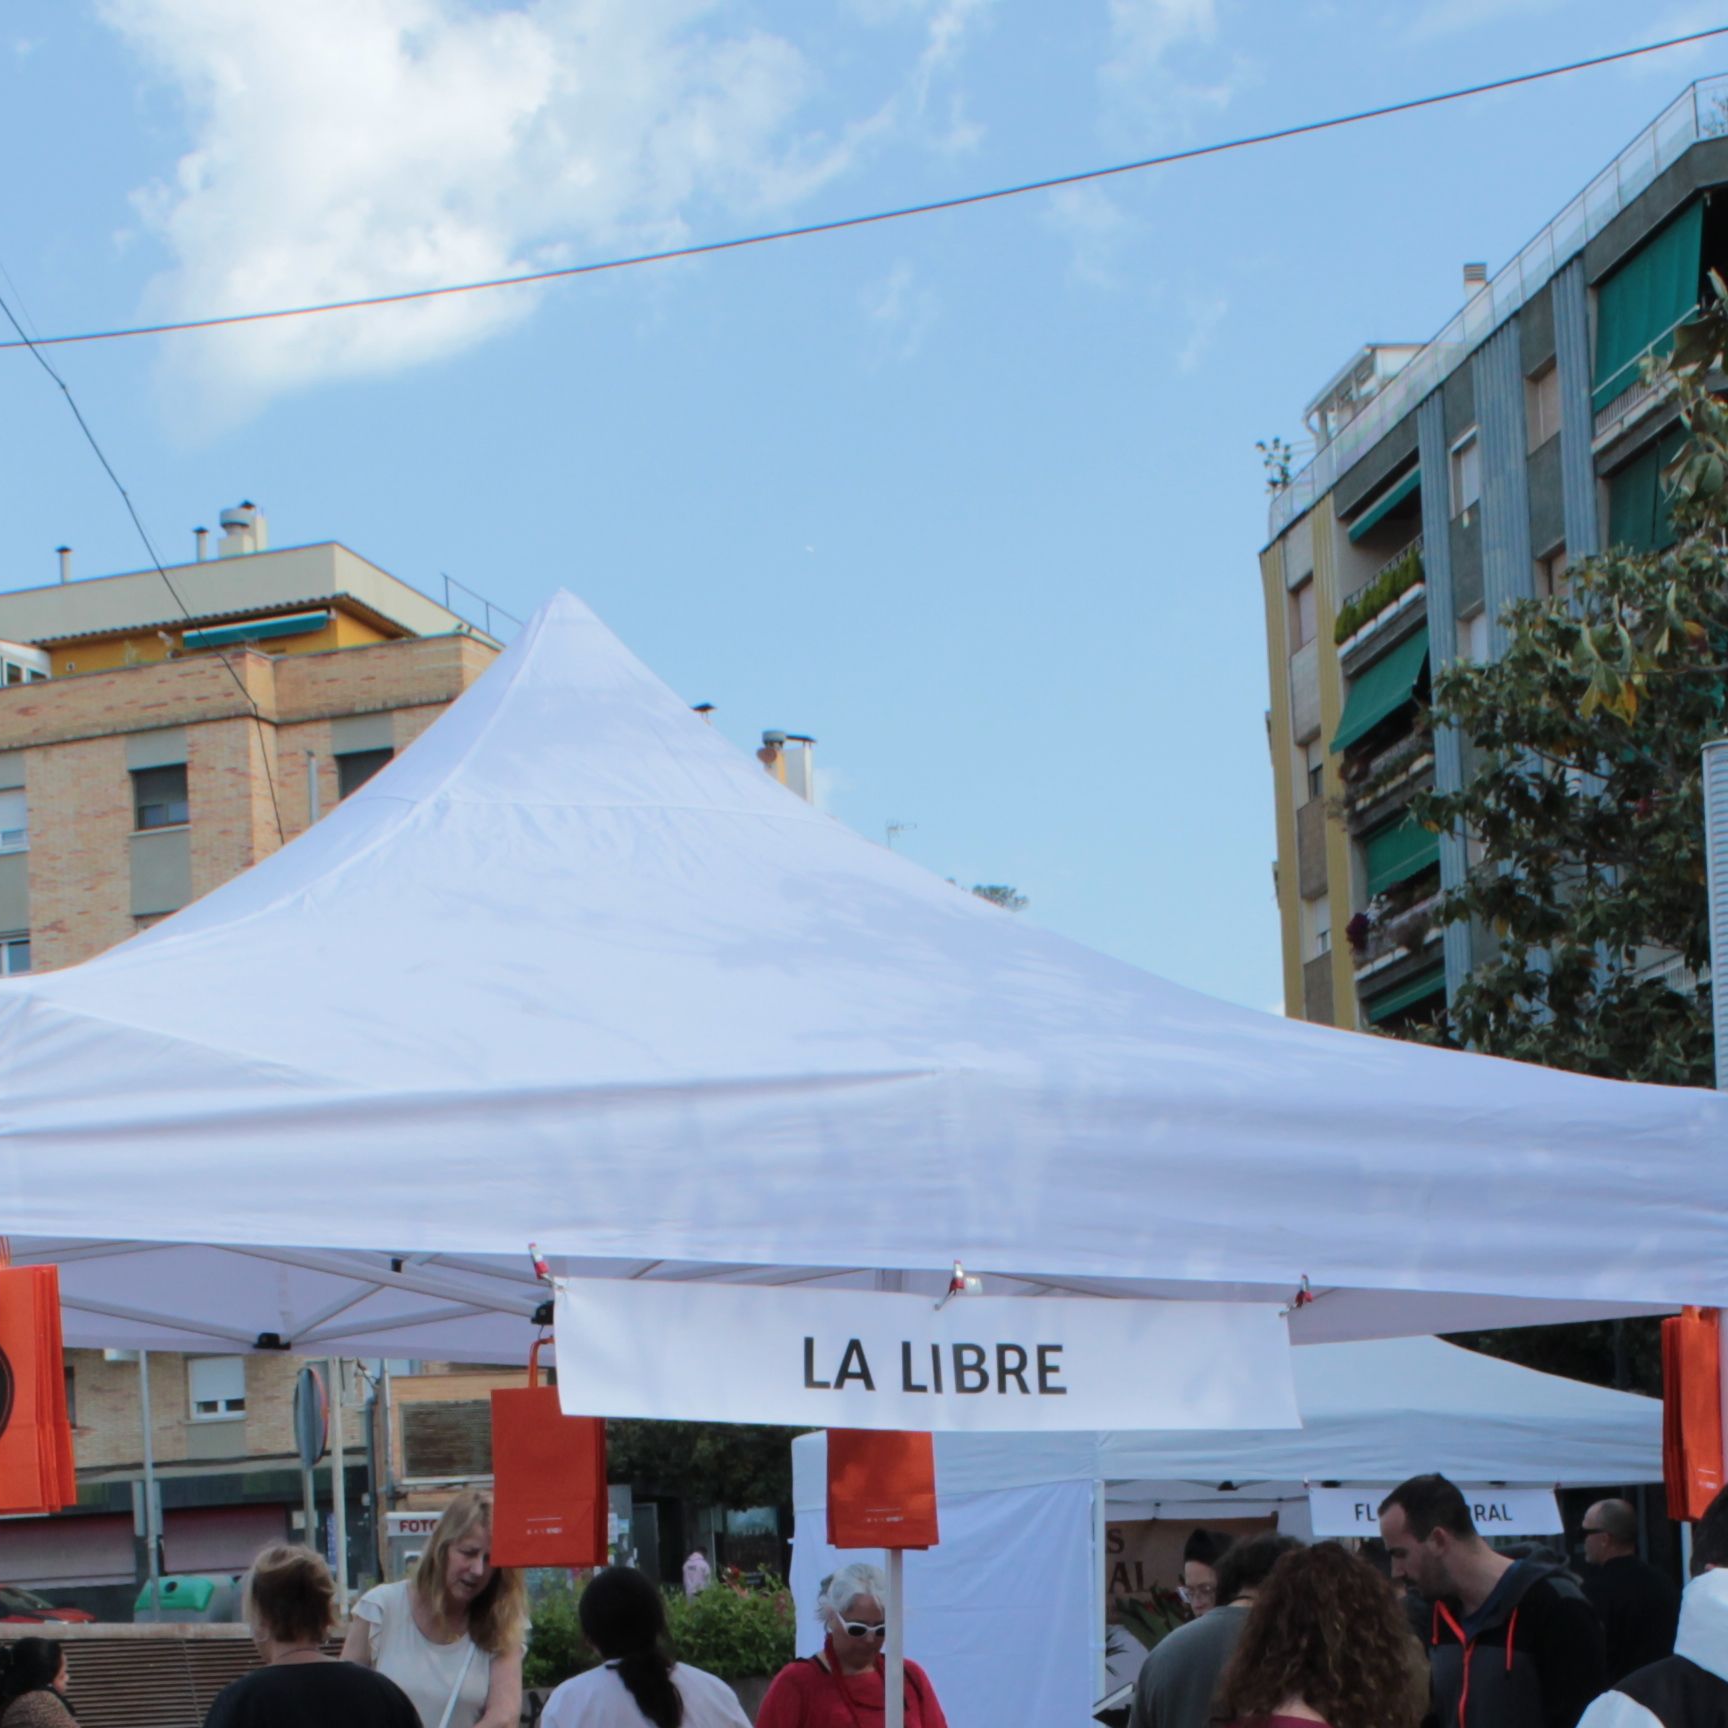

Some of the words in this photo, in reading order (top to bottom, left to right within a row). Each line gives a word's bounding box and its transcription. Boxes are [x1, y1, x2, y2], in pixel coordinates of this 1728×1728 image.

[802, 1335, 876, 1393] LA
[900, 1338, 1069, 1396] LIBRE
[1473, 1504, 1513, 1522] RAL
